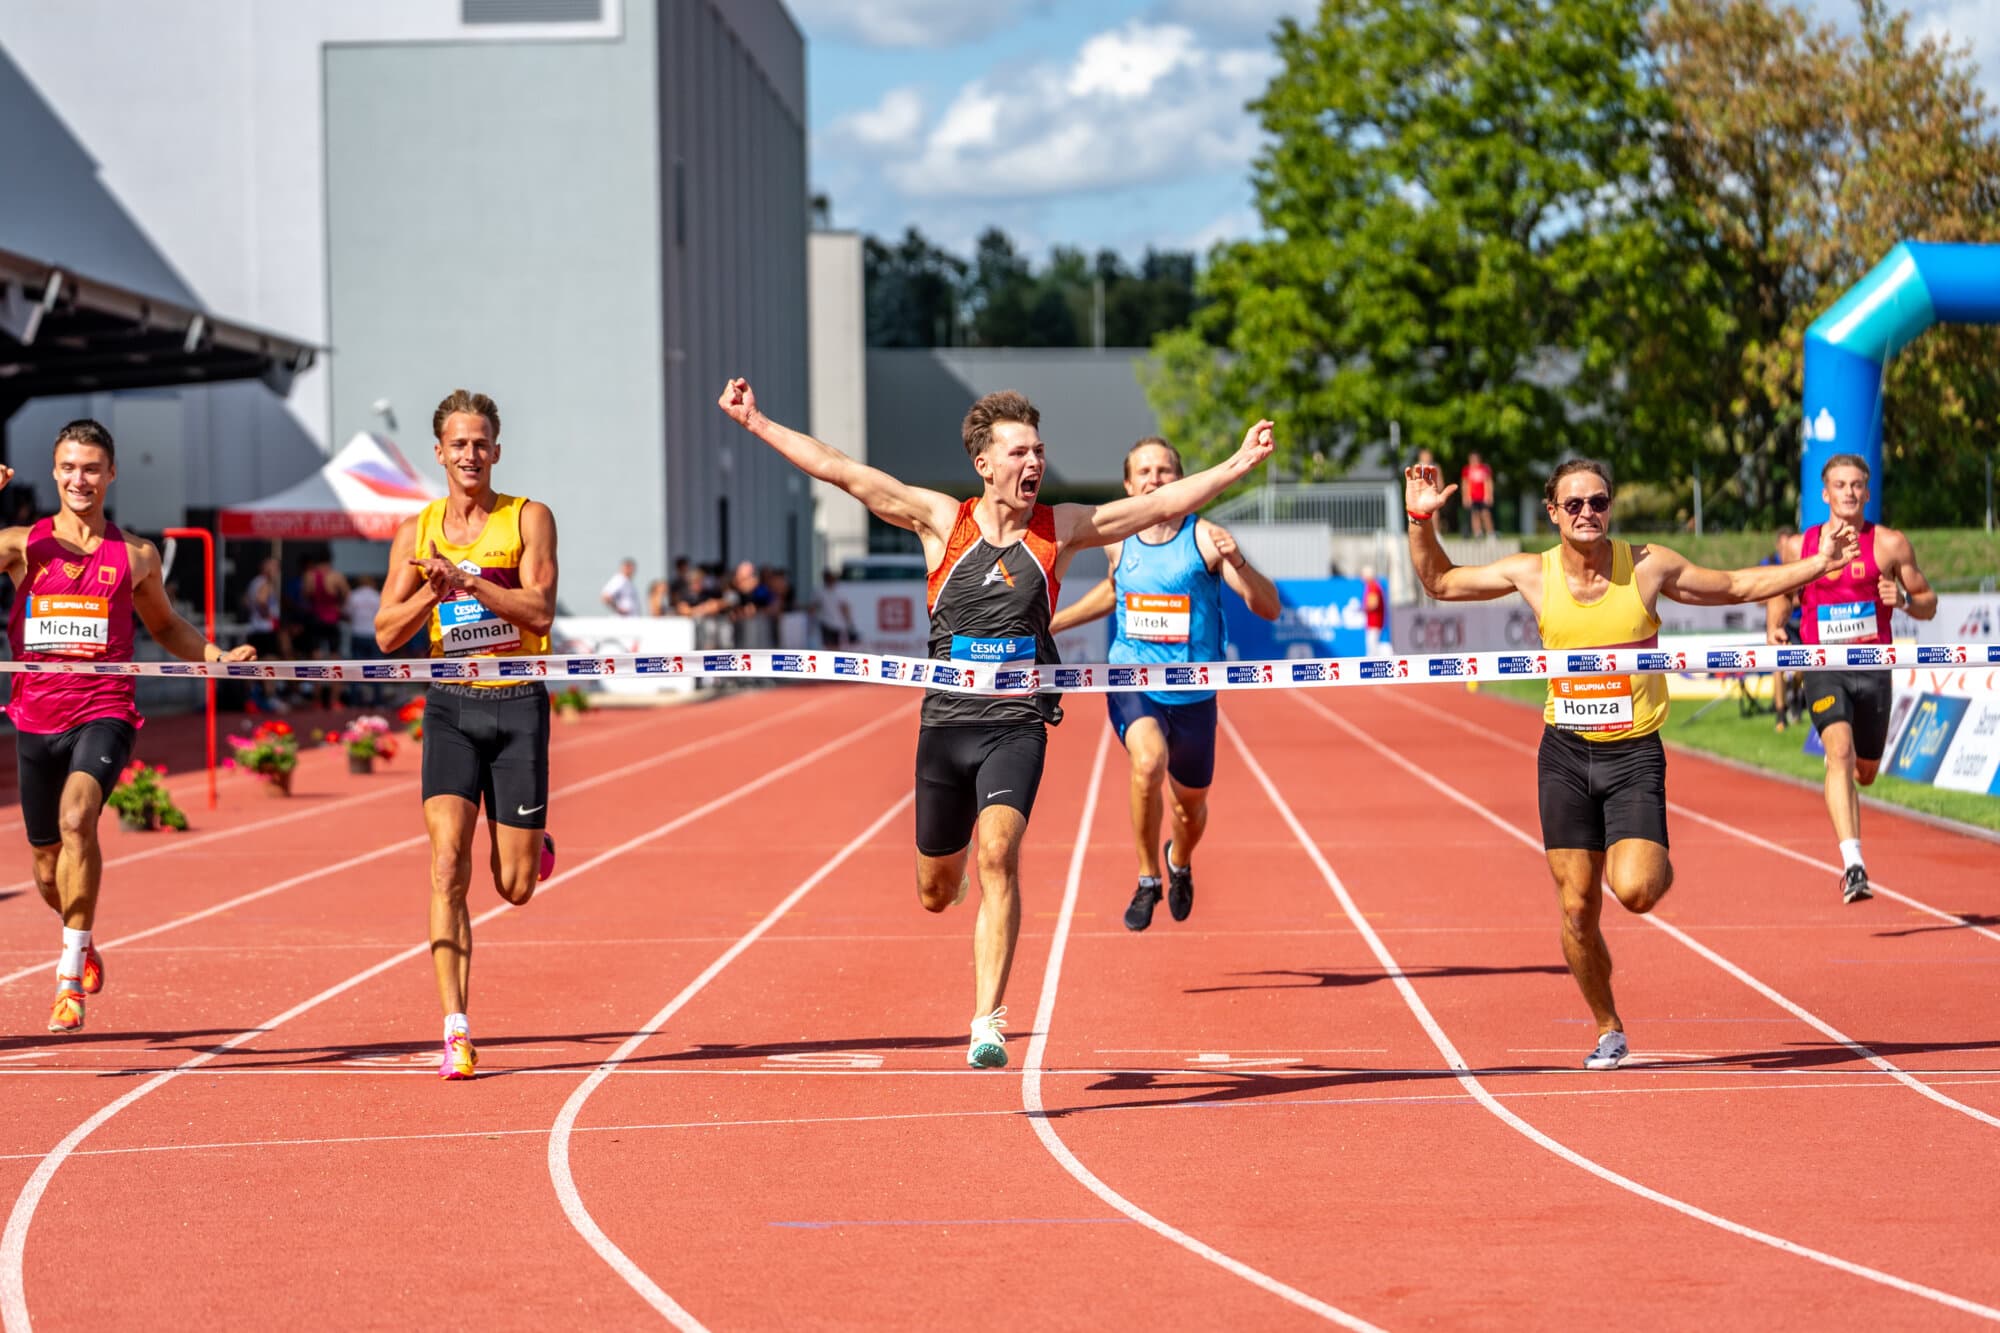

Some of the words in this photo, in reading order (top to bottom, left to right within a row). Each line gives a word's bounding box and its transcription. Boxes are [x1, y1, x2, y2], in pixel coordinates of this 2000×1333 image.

[84, 601, 99, 611] ČEZ
[40, 620, 98, 638] Michal
[451, 623, 514, 643] Roman
[1827, 621, 1865, 634] Adam
[970, 641, 1004, 653] ČESKÁ
[480, 687, 511, 700] PRO
[1574, 683, 1605, 691] SKUPINA
[1563, 700, 1619, 715] Honza
